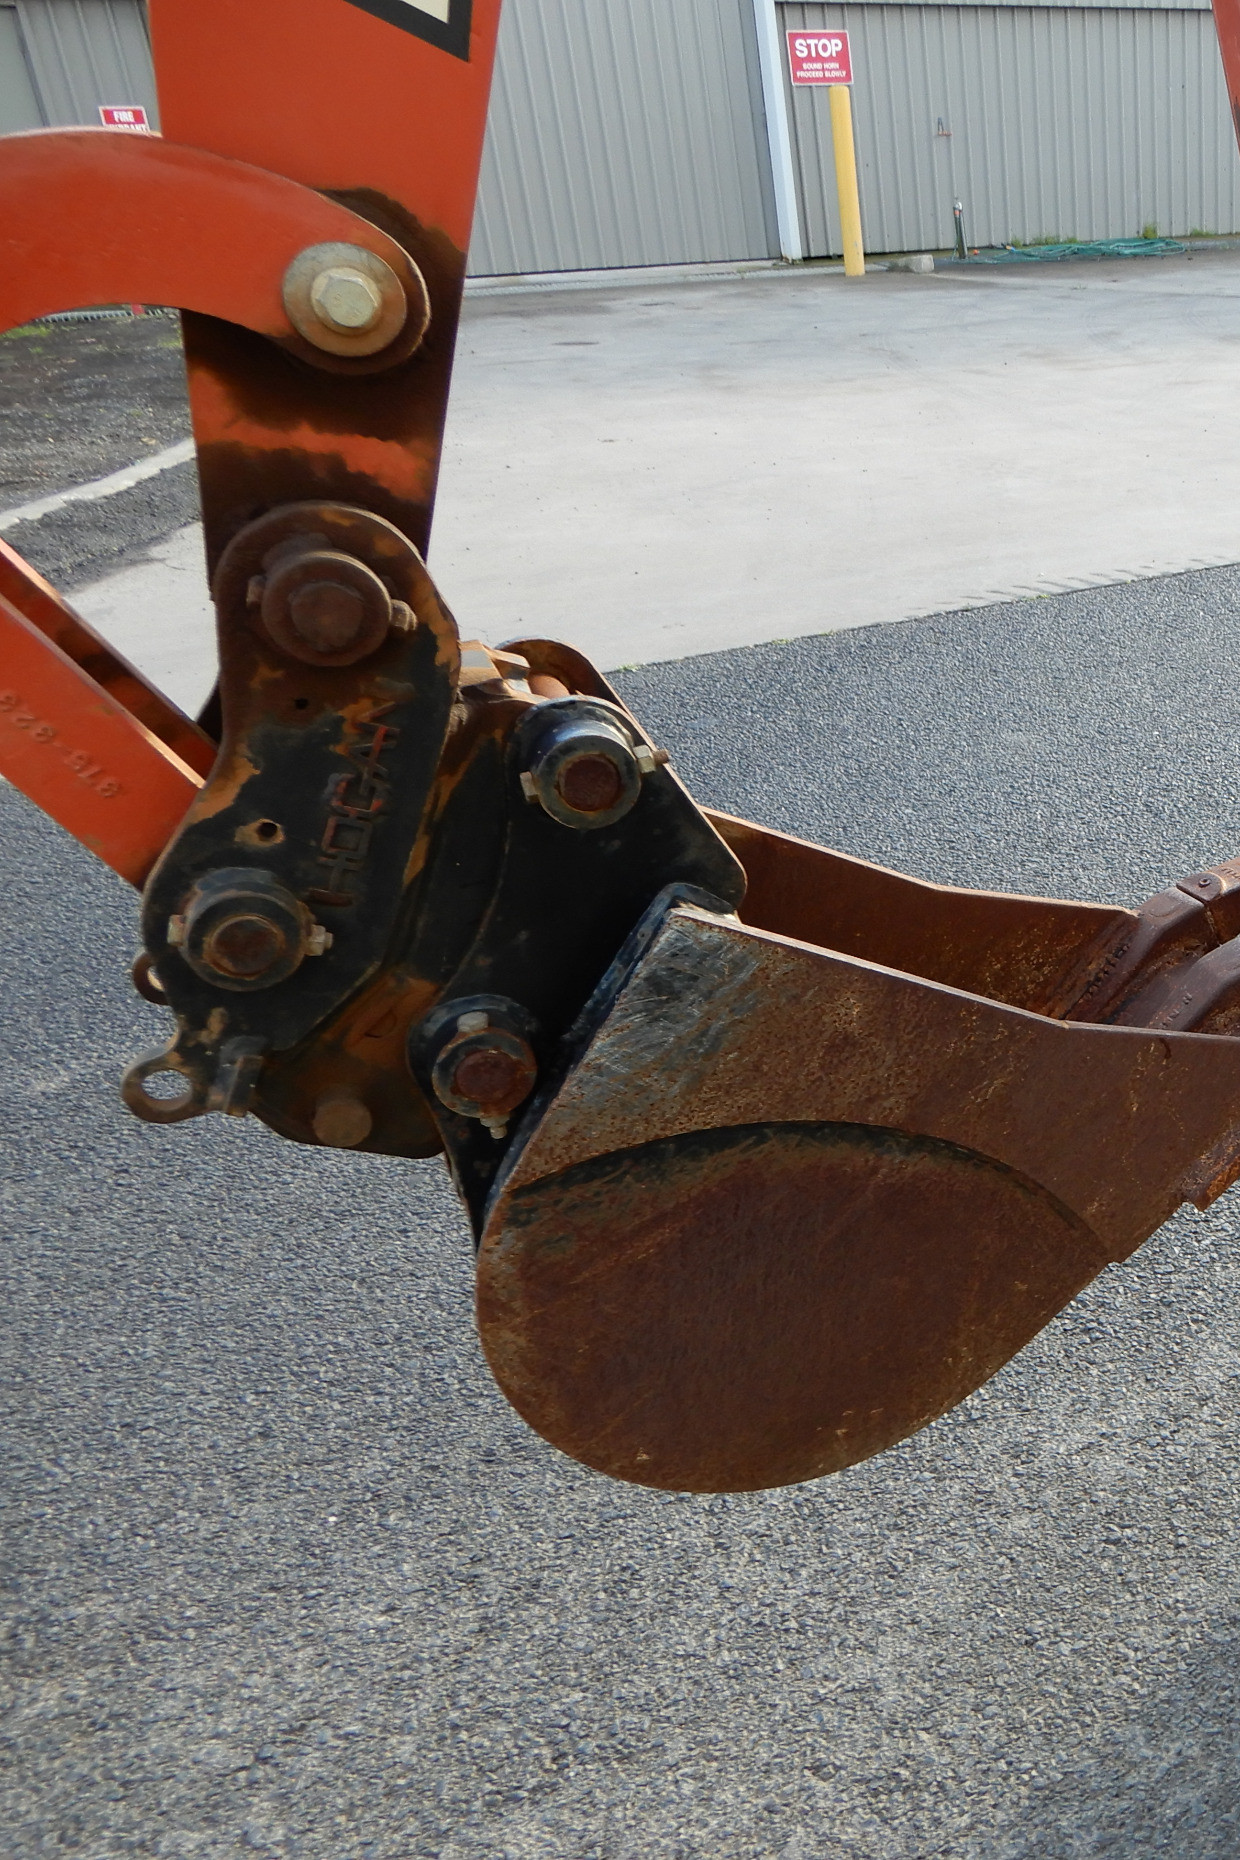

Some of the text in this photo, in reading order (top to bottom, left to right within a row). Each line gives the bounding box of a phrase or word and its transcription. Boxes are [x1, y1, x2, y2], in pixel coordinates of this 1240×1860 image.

[795, 38, 843, 58] STOP
[802, 62, 839, 70] SOUND HORN
[796, 70, 847, 78] PROCEED SLOWLY
[113, 110, 136, 123] FIRE
[301, 682, 414, 906] HOGAN
